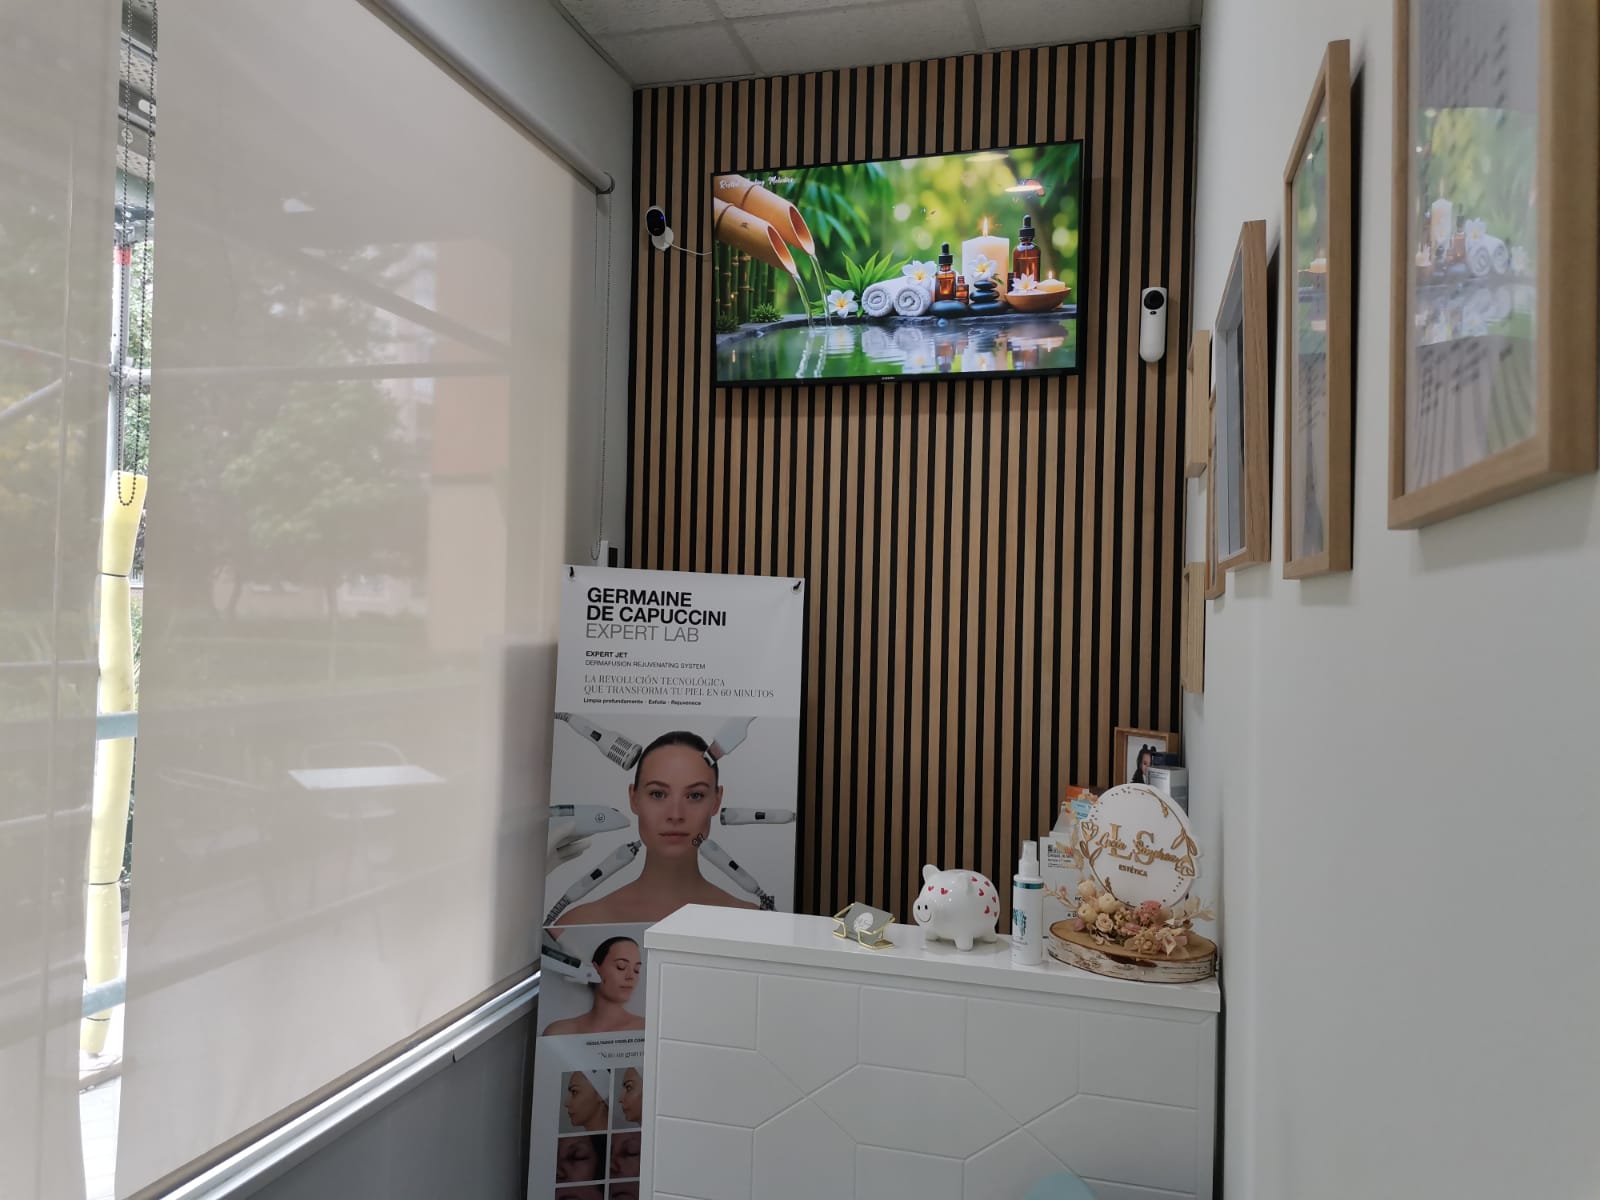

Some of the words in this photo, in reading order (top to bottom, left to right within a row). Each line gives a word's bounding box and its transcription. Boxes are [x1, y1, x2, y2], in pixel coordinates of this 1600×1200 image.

[587, 587, 692, 607] GERMAINE
[587, 605, 614, 621] DE
[619, 606, 726, 626] CAPUCCINI
[586, 623, 659, 640] EXPERT
[664, 626, 699, 642] LAB
[585, 650, 614, 658] EXPERT
[584, 674, 597, 683] LA
[599, 674, 658, 685] REVOLUCIÓN
[661, 676, 726, 687] TECNOLÓGICA
[584, 685, 605, 696] QUE
[606, 686, 669, 695] TRANSFORMA
[671, 687, 683, 696] TU
[685, 687, 705, 697] PIEL
[706, 688, 719, 697] EN
[720, 688, 732, 697] 60
[733, 688, 775, 698] MINUTOS
